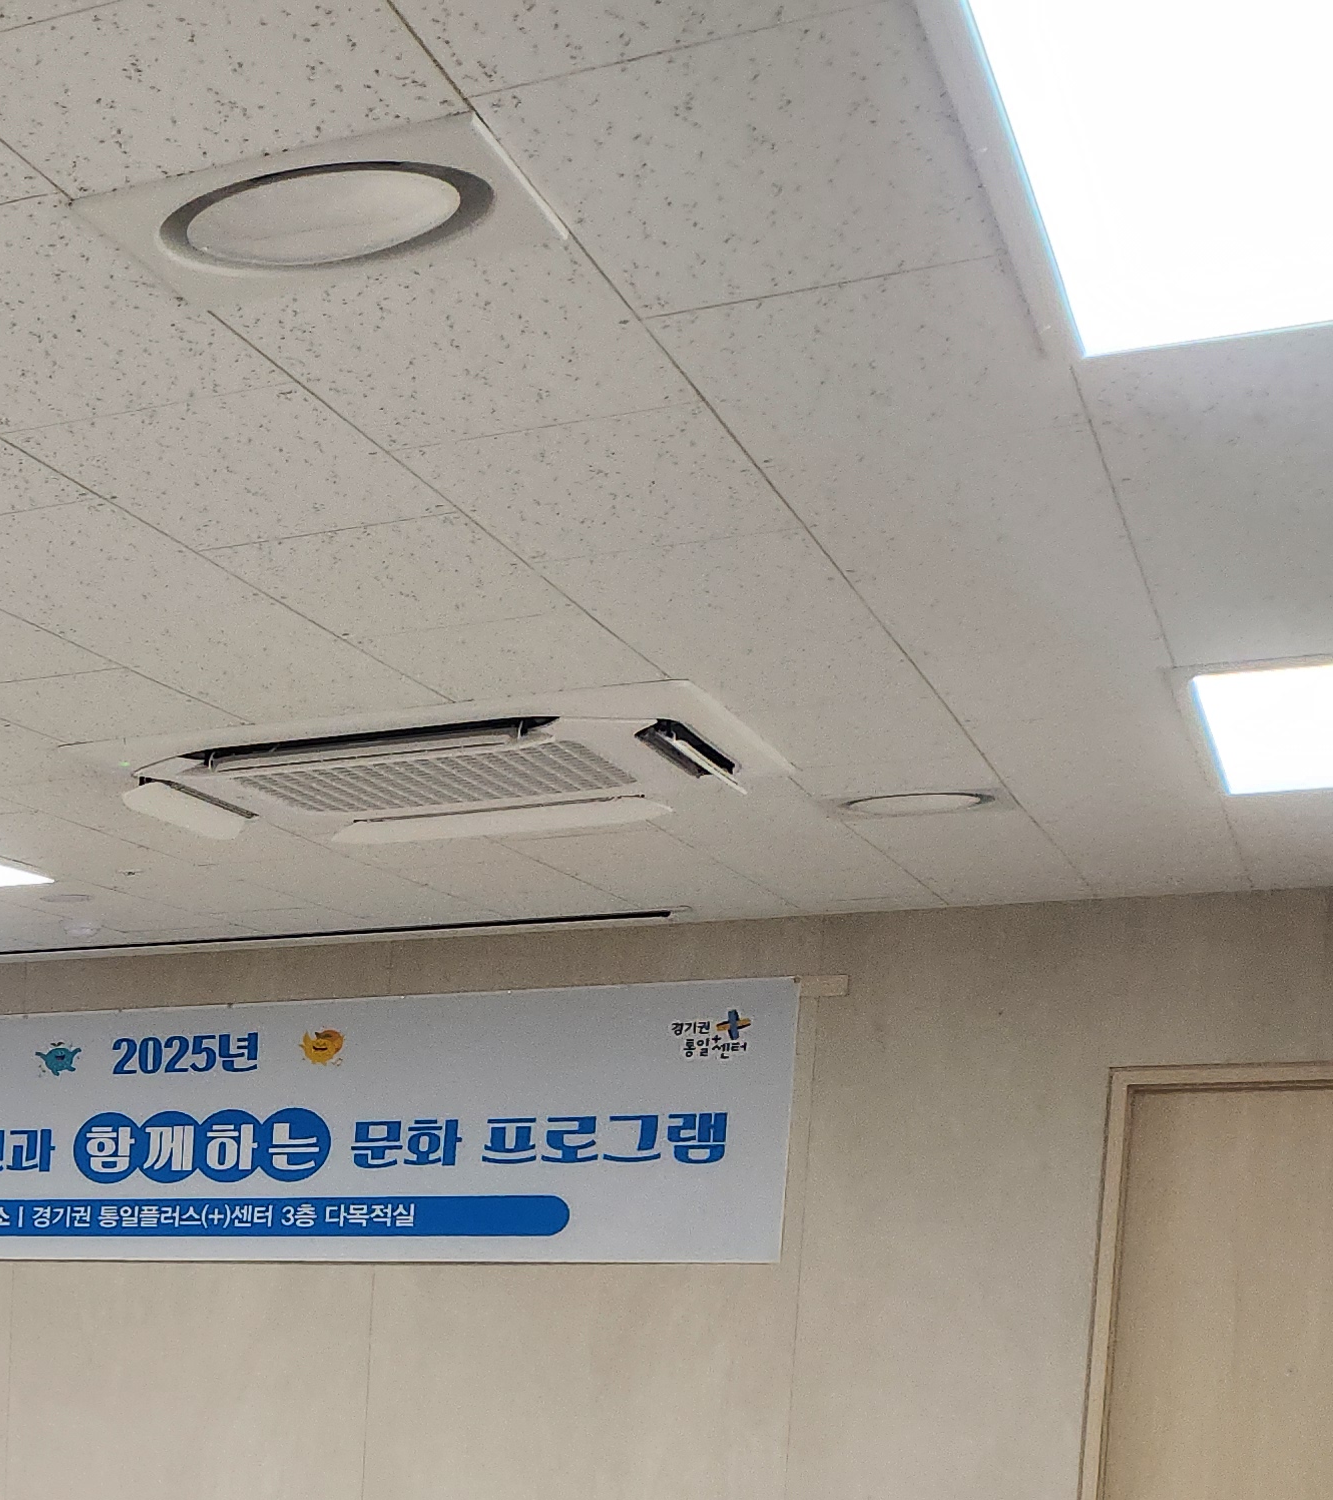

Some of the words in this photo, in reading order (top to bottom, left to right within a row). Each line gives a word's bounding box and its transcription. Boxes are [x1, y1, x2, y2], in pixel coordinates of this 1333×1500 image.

[671, 1020, 710, 1036] 경기권
[113, 1031, 259, 1075] 2025년
[85, 1121, 320, 1172] 함께하는
[351, 1117, 463, 1169] 문화
[480, 1111, 728, 1165] 프로그램
[32, 1206, 91, 1228] 경기권
[98, 1204, 273, 1229] 통일플러스(+)센터
[281, 1204, 317, 1227] 3층
[325, 1203, 415, 1228] 다목적실
